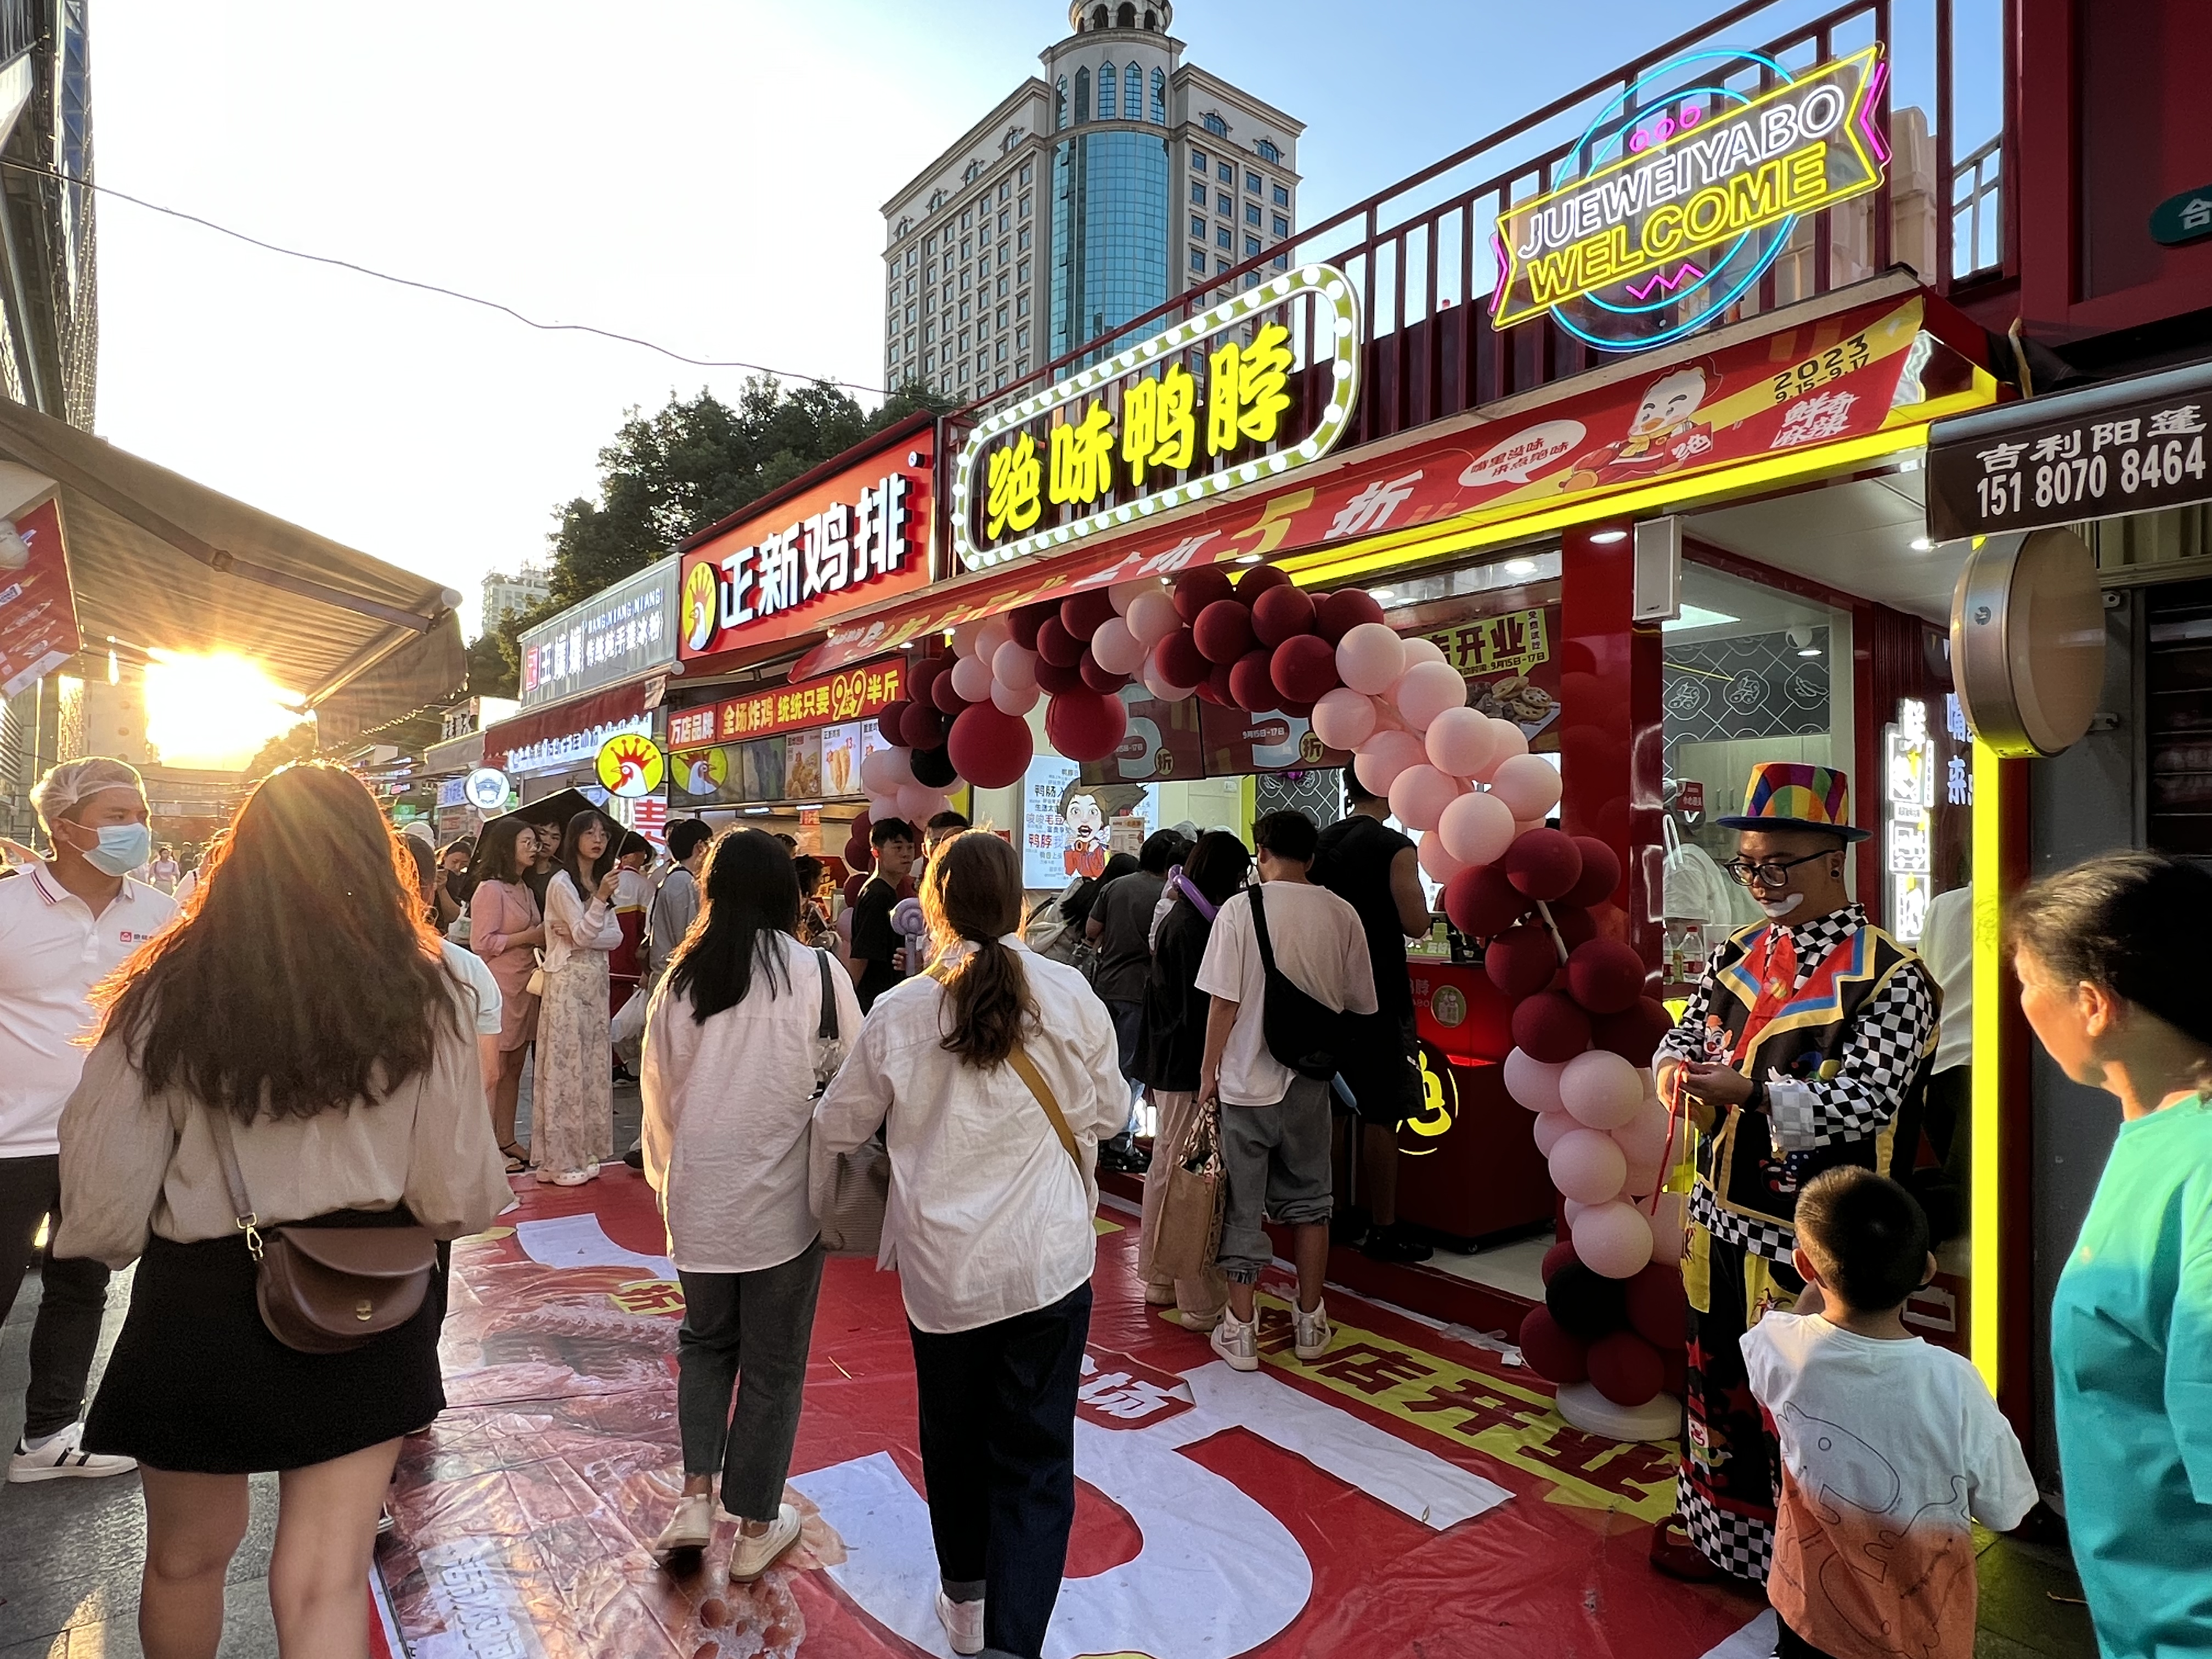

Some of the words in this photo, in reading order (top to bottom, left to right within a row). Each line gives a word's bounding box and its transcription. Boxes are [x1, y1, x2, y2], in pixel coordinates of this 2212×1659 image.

[1517, 84, 1845, 259] JUEWEIYABO
[1527, 142, 1826, 304] WELCOME
[2178, 198, 2212, 230] 合
[1774, 334, 1868, 392] 2023
[1775, 353, 1870, 403] 9.15-9.17
[987, 321, 1295, 540] 绝味鸭脖
[1470, 438, 1544, 473] 嘴里没味
[1491, 442, 1569, 477] 来点绝味
[1977, 470, 2022, 518] 151
[2035, 454, 2107, 508] 8070
[2121, 436, 2207, 494] 8464
[720, 472, 908, 629] 正新鸡排
[670, 710, 714, 745] 万店品牌
[723, 696, 774, 735] 全场炸鸡
[1158, 753, 1173, 775] 折
[1300, 736, 1323, 759] 折
